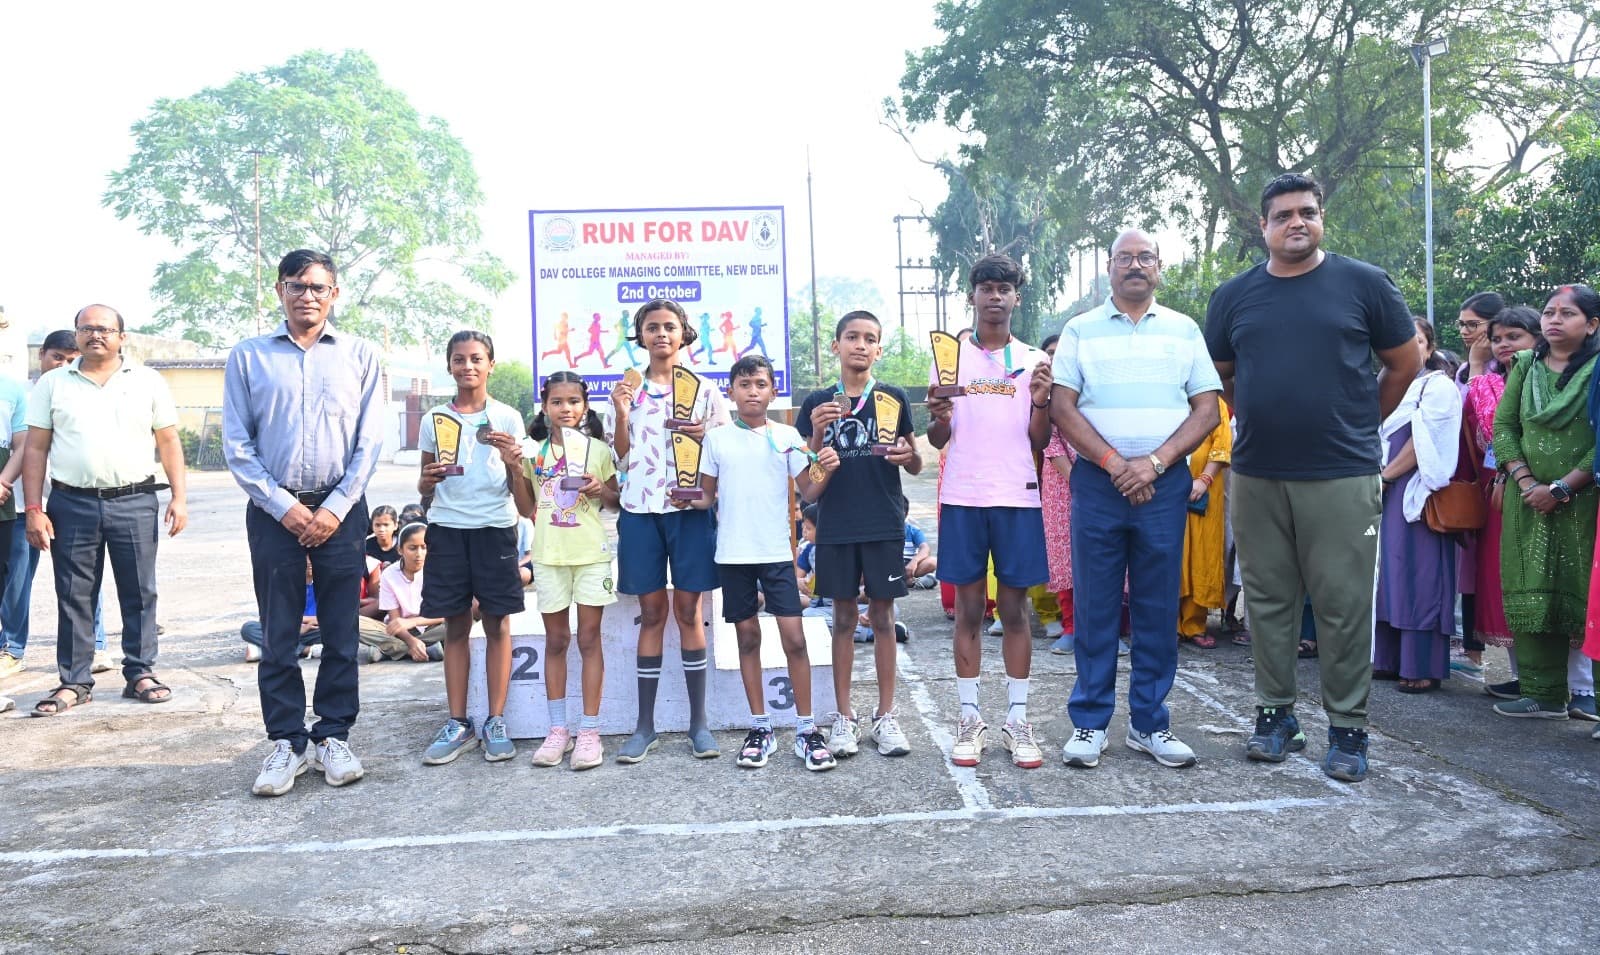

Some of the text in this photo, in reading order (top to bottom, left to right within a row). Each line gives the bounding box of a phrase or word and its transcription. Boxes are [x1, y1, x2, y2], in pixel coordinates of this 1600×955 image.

[582, 222, 635, 244] RUN
[643, 221, 693, 243] FOR
[701, 220, 749, 242] DAV
[625, 251, 673, 261] MANAGED
[540, 264, 779, 279] DAV COLLEGE MANAGING COMMITTEE, NEW DELHI
[621, 284, 698, 299] 2nd October
[585, 381, 599, 391] AV
[510, 646, 540, 681] 2
[767, 676, 796, 710] 3
